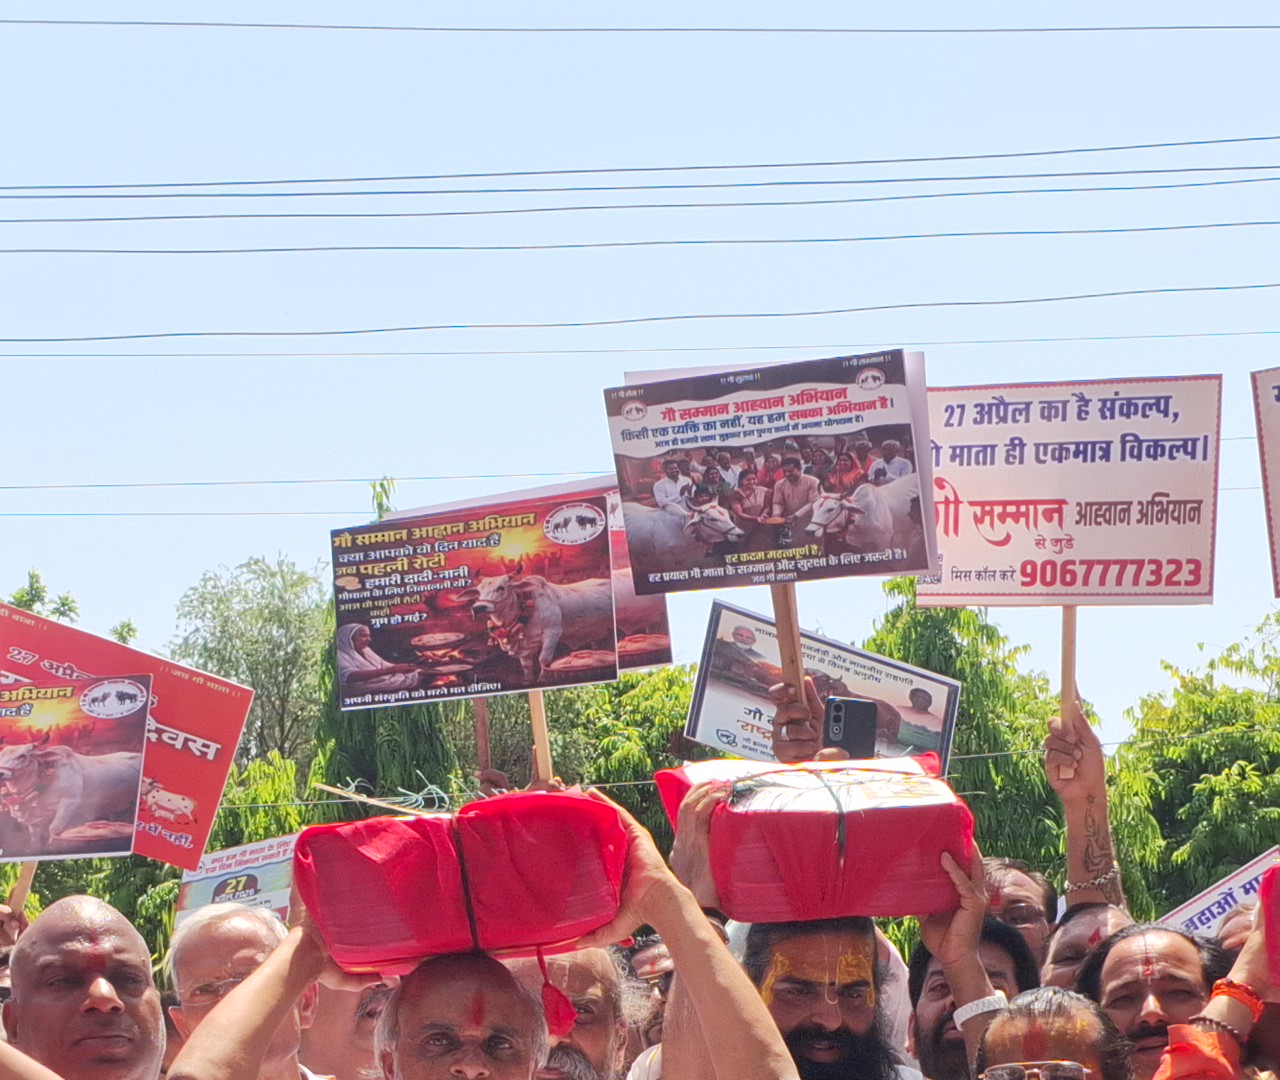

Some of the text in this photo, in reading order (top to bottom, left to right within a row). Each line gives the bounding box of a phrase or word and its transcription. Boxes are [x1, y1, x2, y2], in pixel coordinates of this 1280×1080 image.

[660, 407, 674, 423] गौ
[677, 404, 730, 423] सम्मान
[789, 386, 849, 406] अभियान
[944, 391, 1179, 427] 27 अप्रैल का है संकल्प,
[621, 429, 649, 442] किसी
[651, 426, 669, 439] एक
[671, 423, 700, 437] व्यक्ति
[703, 420, 717, 432] का
[746, 415, 765, 426] यह
[767, 412, 786, 424] हम
[788, 406, 823, 421] सबका
[826, 399, 877, 417] अभियान
[949, 444, 999, 466] माता
[1003, 436, 1027, 465] ही
[1033, 440, 1113, 464] एकमात्र
[1120, 433, 1209, 461] विकल्प।
[333, 533, 353, 548] गौ
[356, 528, 409, 546] सम्मान
[467, 513, 536, 533] अभियान
[966, 498, 1069, 547] सम्मान
[1135, 492, 1203, 525] अभियान
[1035, 534, 1047, 549] से
[335, 554, 446, 576] जब पहली रोटी
[950, 566, 972, 583] मिस
[974, 566, 996, 582] कॉल
[1020, 558, 1202, 588] 9067777323
[364, 574, 401, 589] हमारी
[7, 647, 38, 665] 27
[0, 685, 74, 701] अभियान
[225, 876, 248, 894] 27
